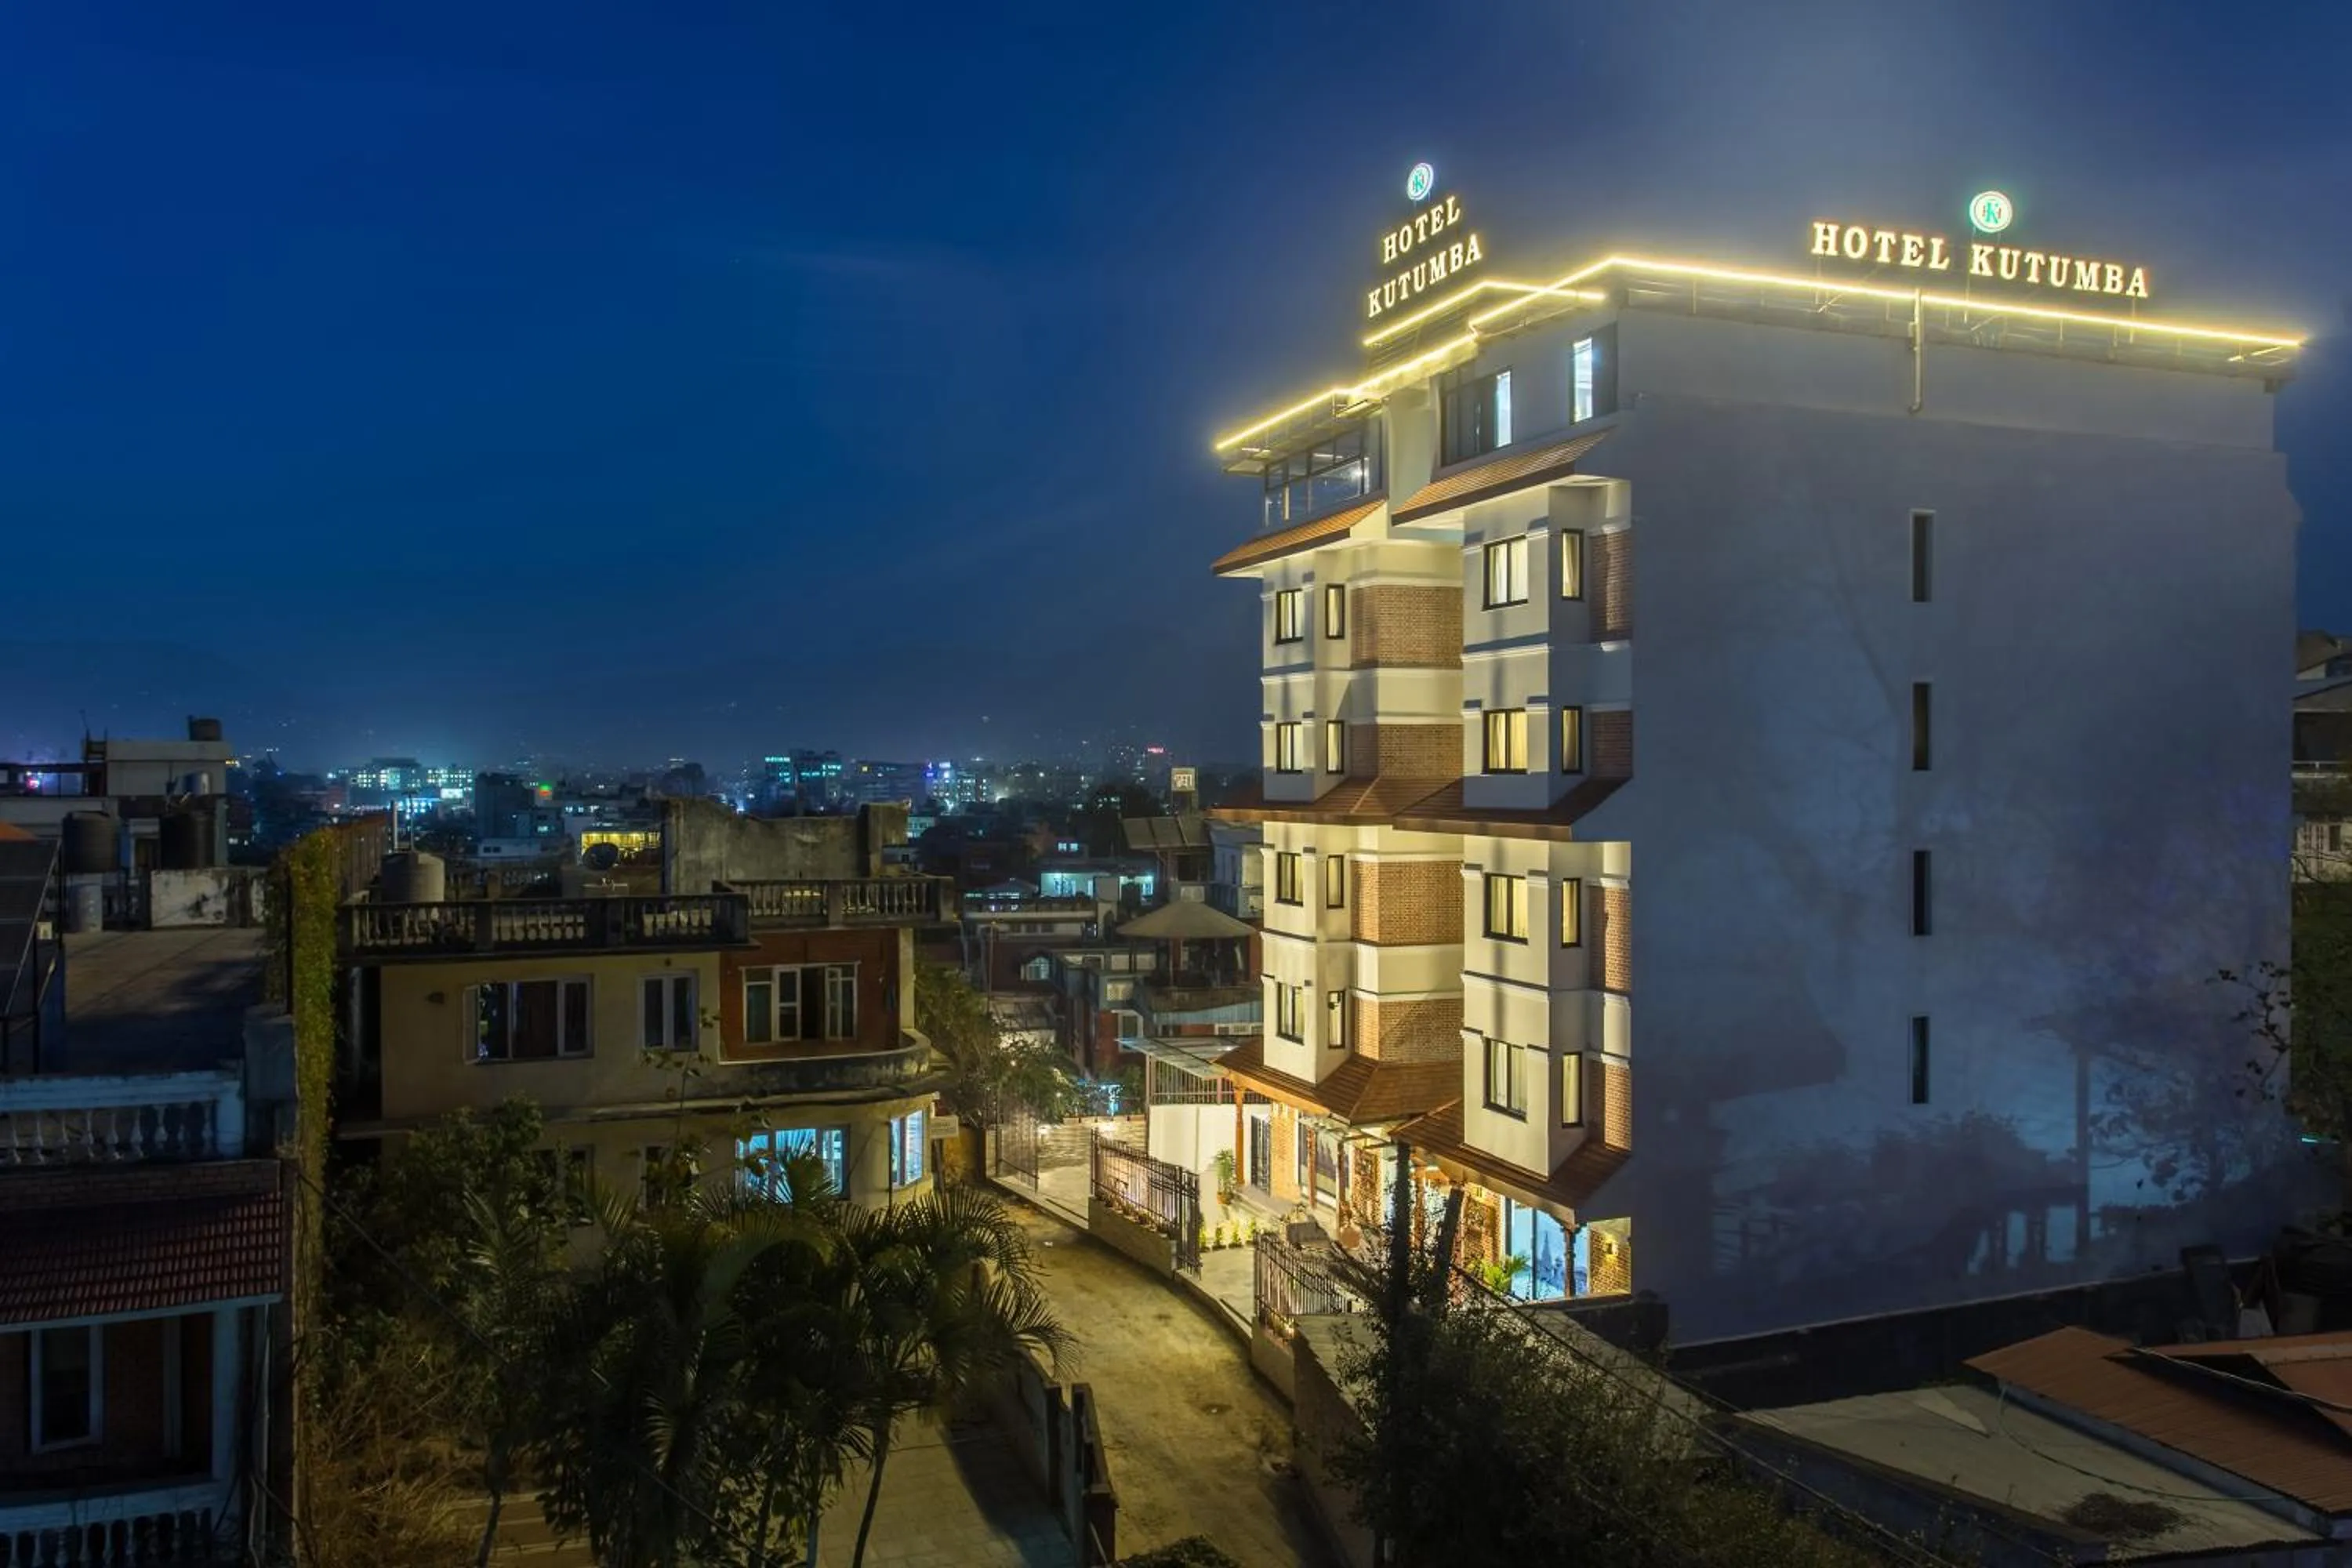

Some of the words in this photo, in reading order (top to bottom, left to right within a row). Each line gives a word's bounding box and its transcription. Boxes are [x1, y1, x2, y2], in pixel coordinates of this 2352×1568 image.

[1383, 196, 1461, 264] HOTEL
[1811, 222, 1950, 270] HOTEL
[1969, 243, 2148, 298] KUTUMBA
[1368, 234, 1483, 318] KUTUMBA
